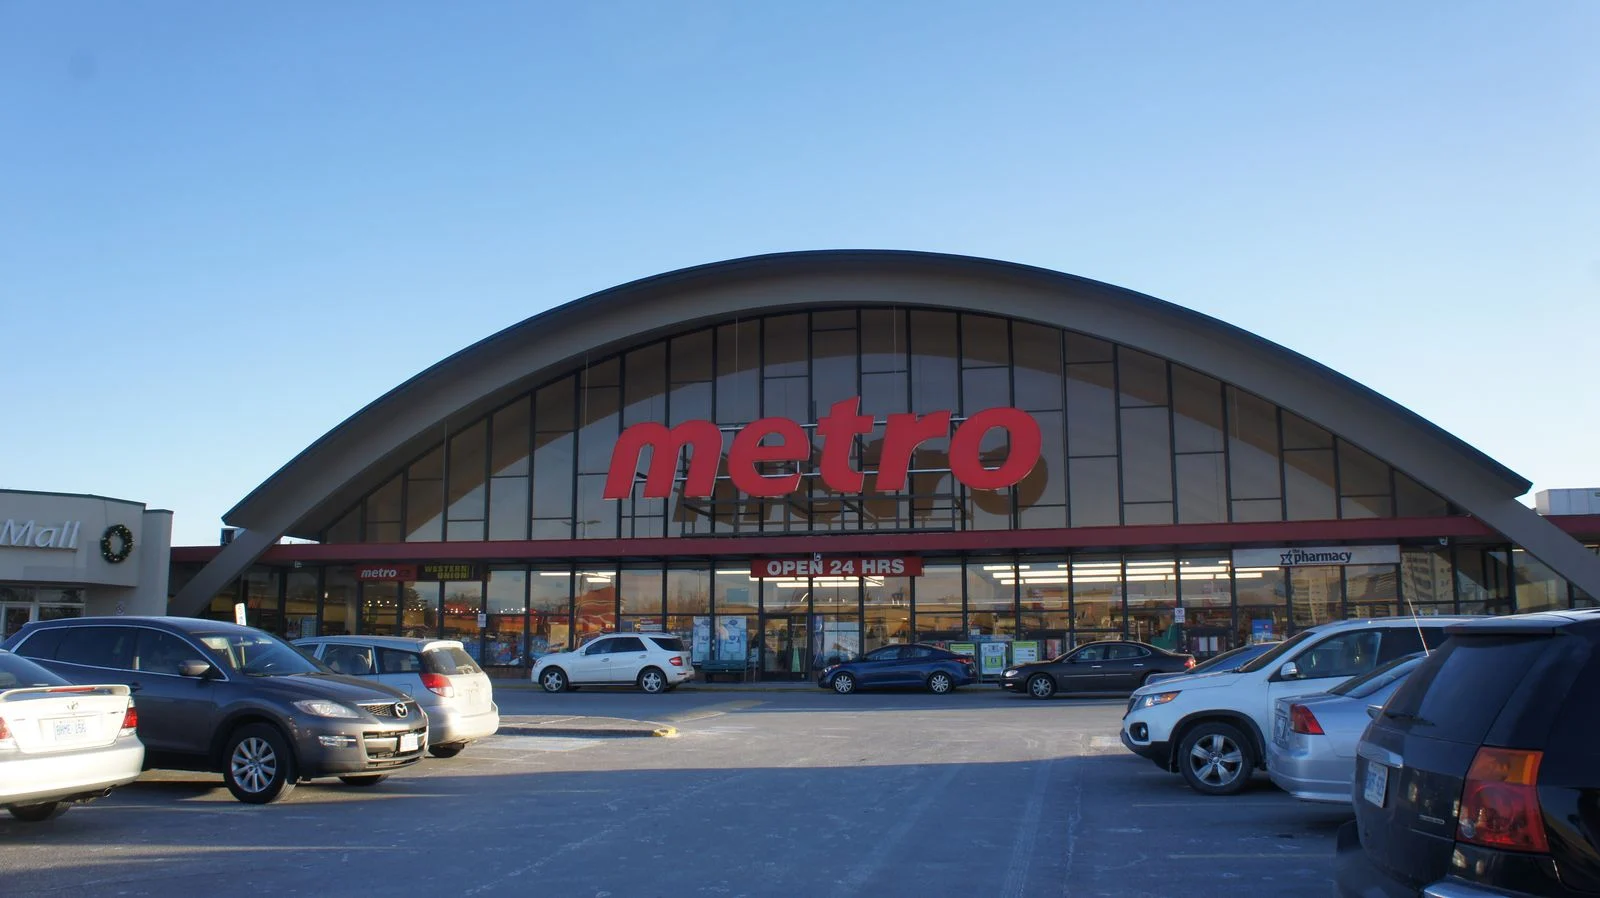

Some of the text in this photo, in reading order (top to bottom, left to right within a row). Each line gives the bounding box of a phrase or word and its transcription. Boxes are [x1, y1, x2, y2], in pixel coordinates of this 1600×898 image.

[603, 396, 1042, 500] metro
[0, 519, 80, 548] Mall
[1294, 549, 1352, 564] pharmacy
[361, 567, 397, 578] metro
[424, 565, 469, 573] WESTERN
[767, 558, 905, 576] OPEN 24 HRS
